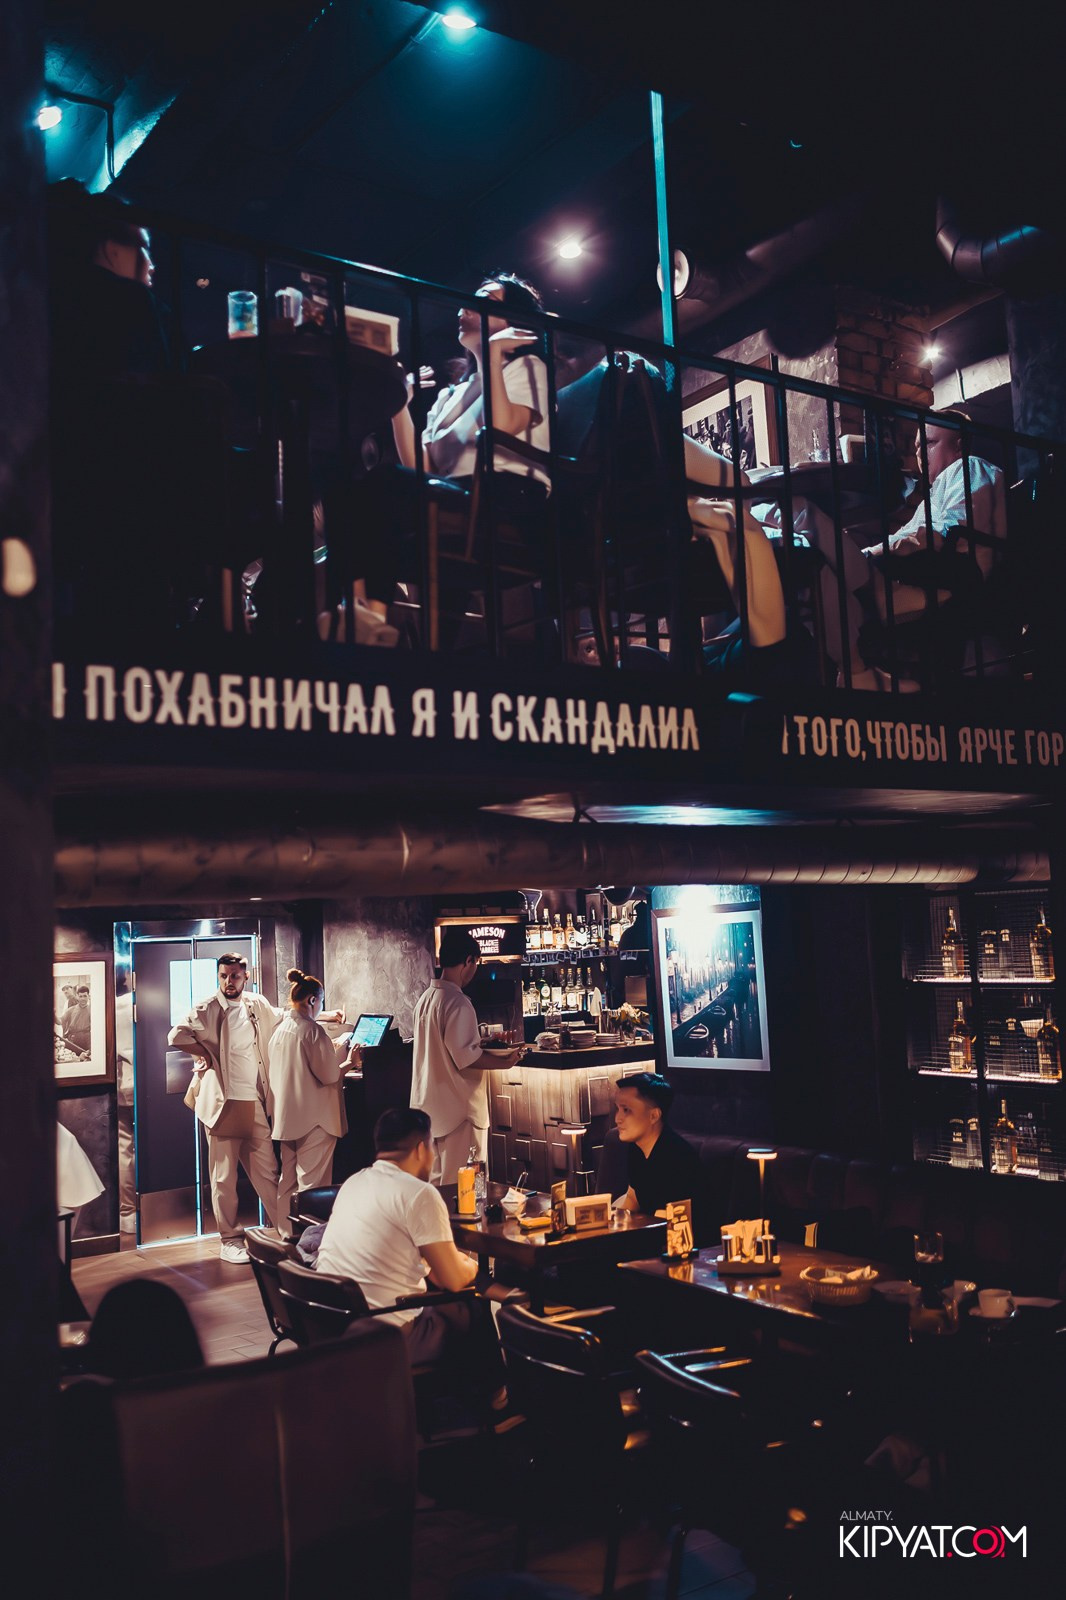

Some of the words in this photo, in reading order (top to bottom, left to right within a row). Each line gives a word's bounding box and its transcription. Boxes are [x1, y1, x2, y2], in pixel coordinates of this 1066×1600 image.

[83, 664, 397, 736] ПОХАБНИЧАЛ
[411, 687, 437, 739] Я
[451, 690, 480, 741] И
[489, 692, 700, 755] СКАНДАЛИЛ
[957, 726, 1018, 765] ЯРЧЕ
